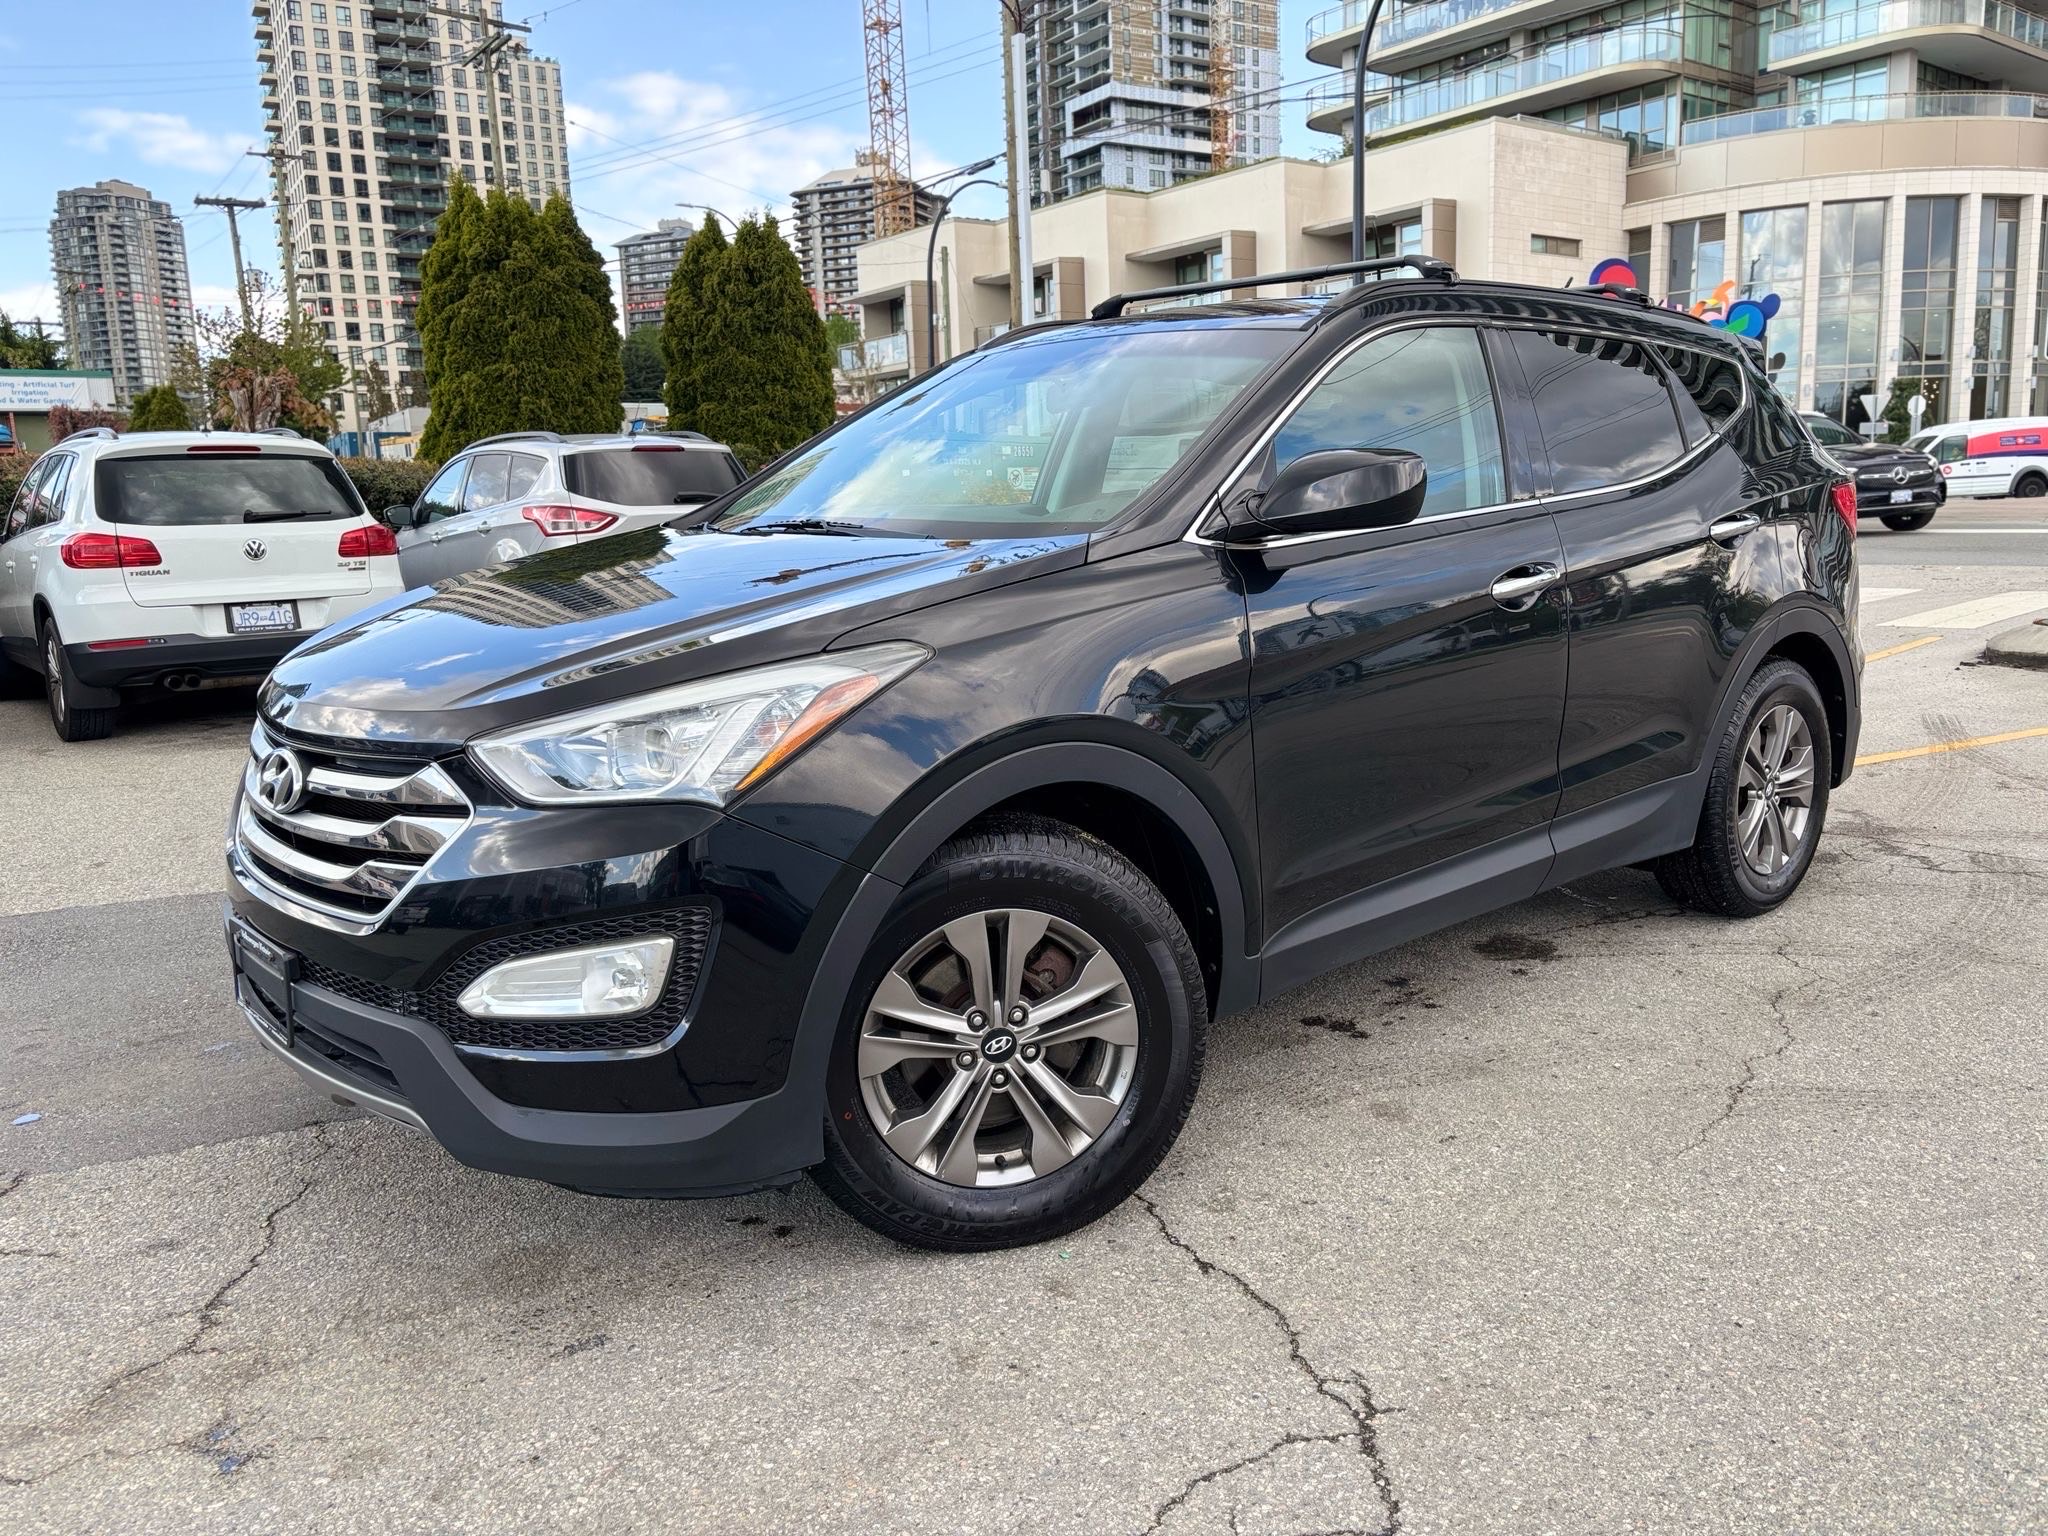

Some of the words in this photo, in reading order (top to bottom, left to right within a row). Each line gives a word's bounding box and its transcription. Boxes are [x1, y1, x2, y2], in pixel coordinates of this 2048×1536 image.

[12, 389, 49, 397] Irrigation
[128, 569, 171, 577] TIGUAN
[235, 612, 260, 626] JR9
[268, 609, 293, 624] 41G
[974, 858, 1146, 926] UNIROYAL
